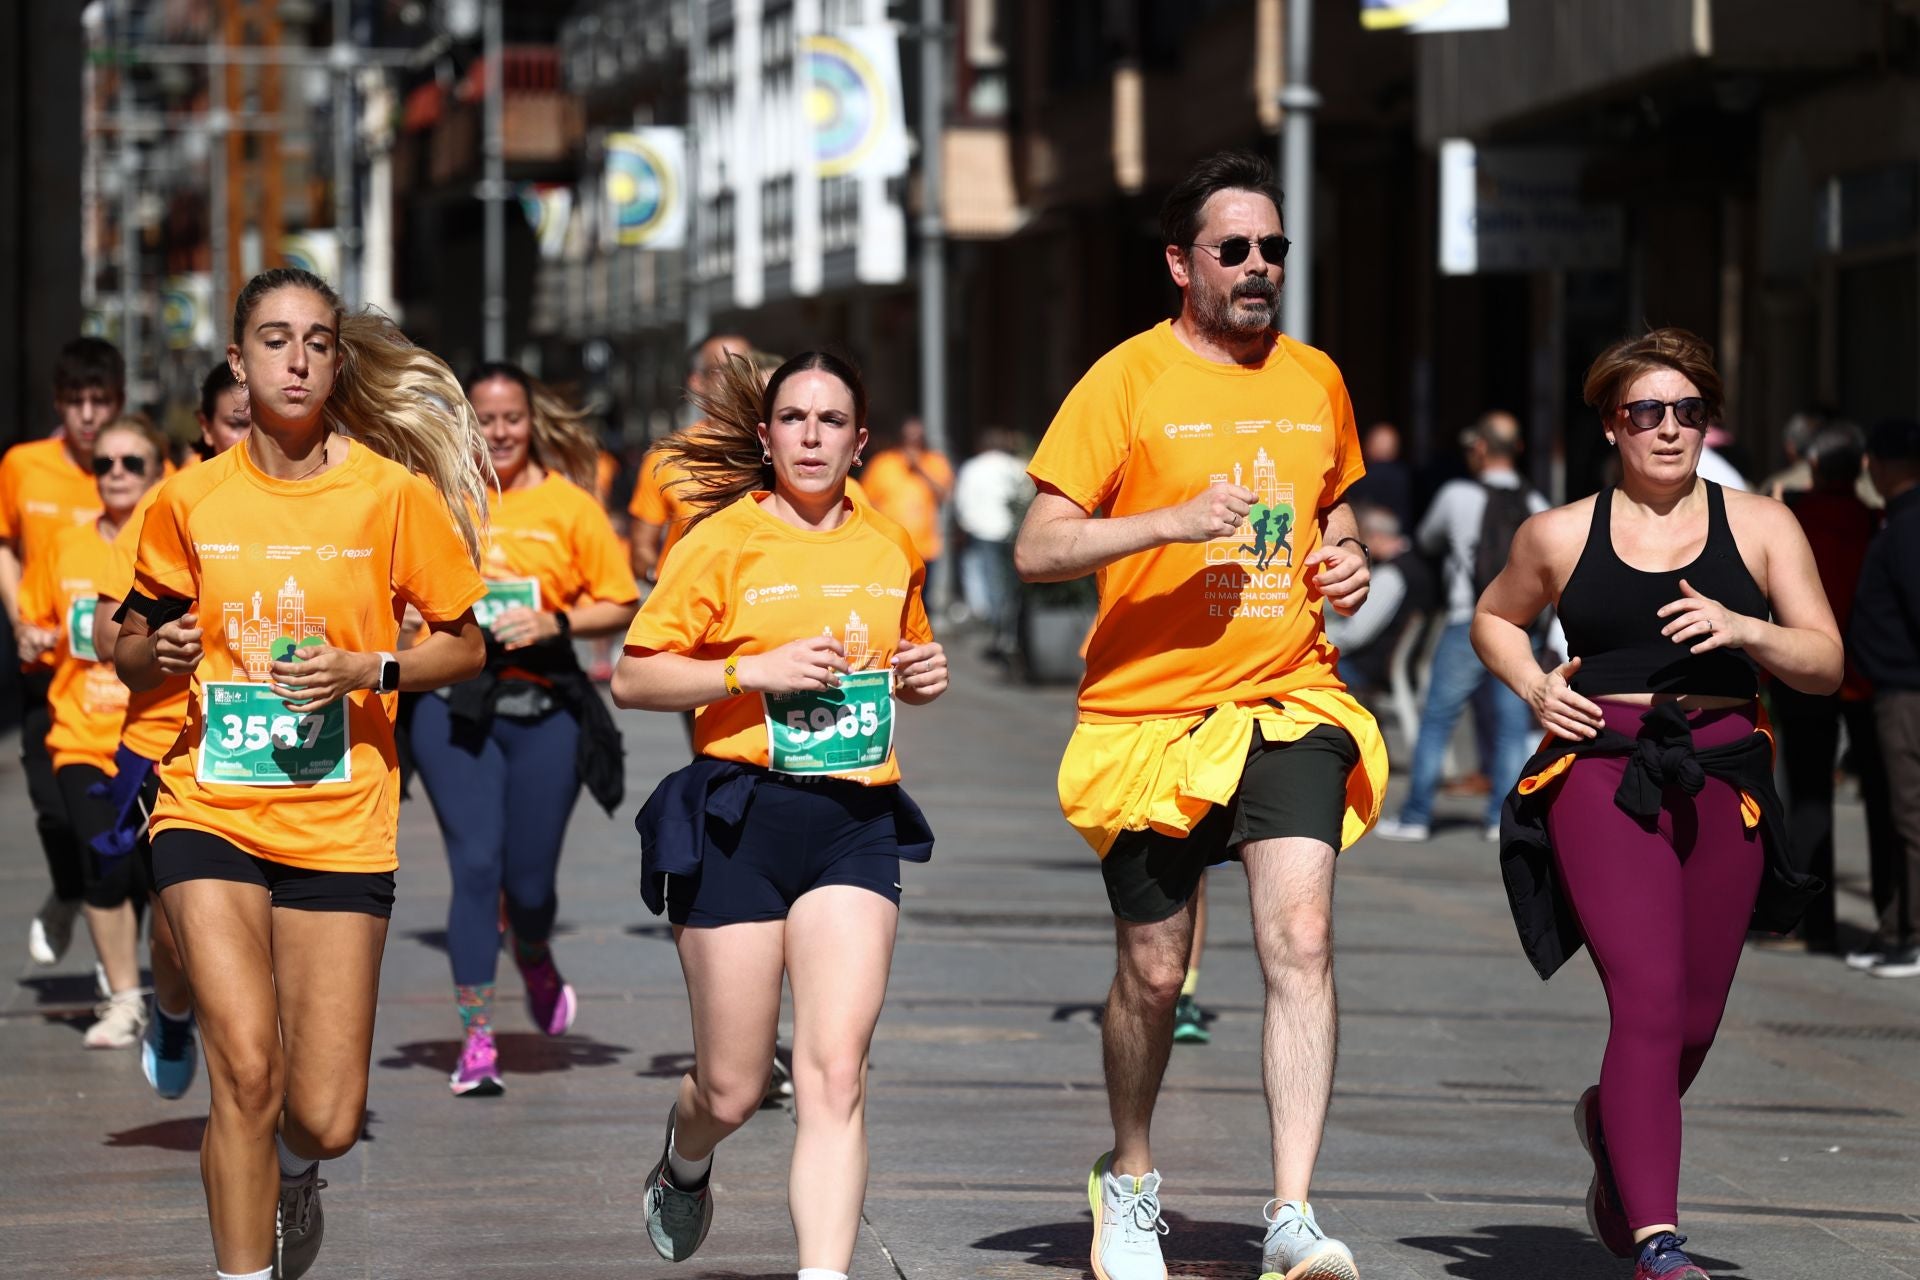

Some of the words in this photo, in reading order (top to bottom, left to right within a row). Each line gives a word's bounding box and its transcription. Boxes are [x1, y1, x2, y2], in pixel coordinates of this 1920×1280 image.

[1179, 423, 1212, 432] oregón
[200, 542, 240, 554] oregón
[341, 547, 373, 560] repsol
[1205, 573, 1291, 589] PALENCIA
[759, 583, 798, 596] oregón
[1205, 591, 1216, 599] EN
[1218, 591, 1258, 600] MARCHA
[1209, 605, 1224, 617] EL
[1228, 602, 1285, 618] CÁNCER
[786, 702, 878, 743] 5965
[221, 714, 325, 750] 3567
